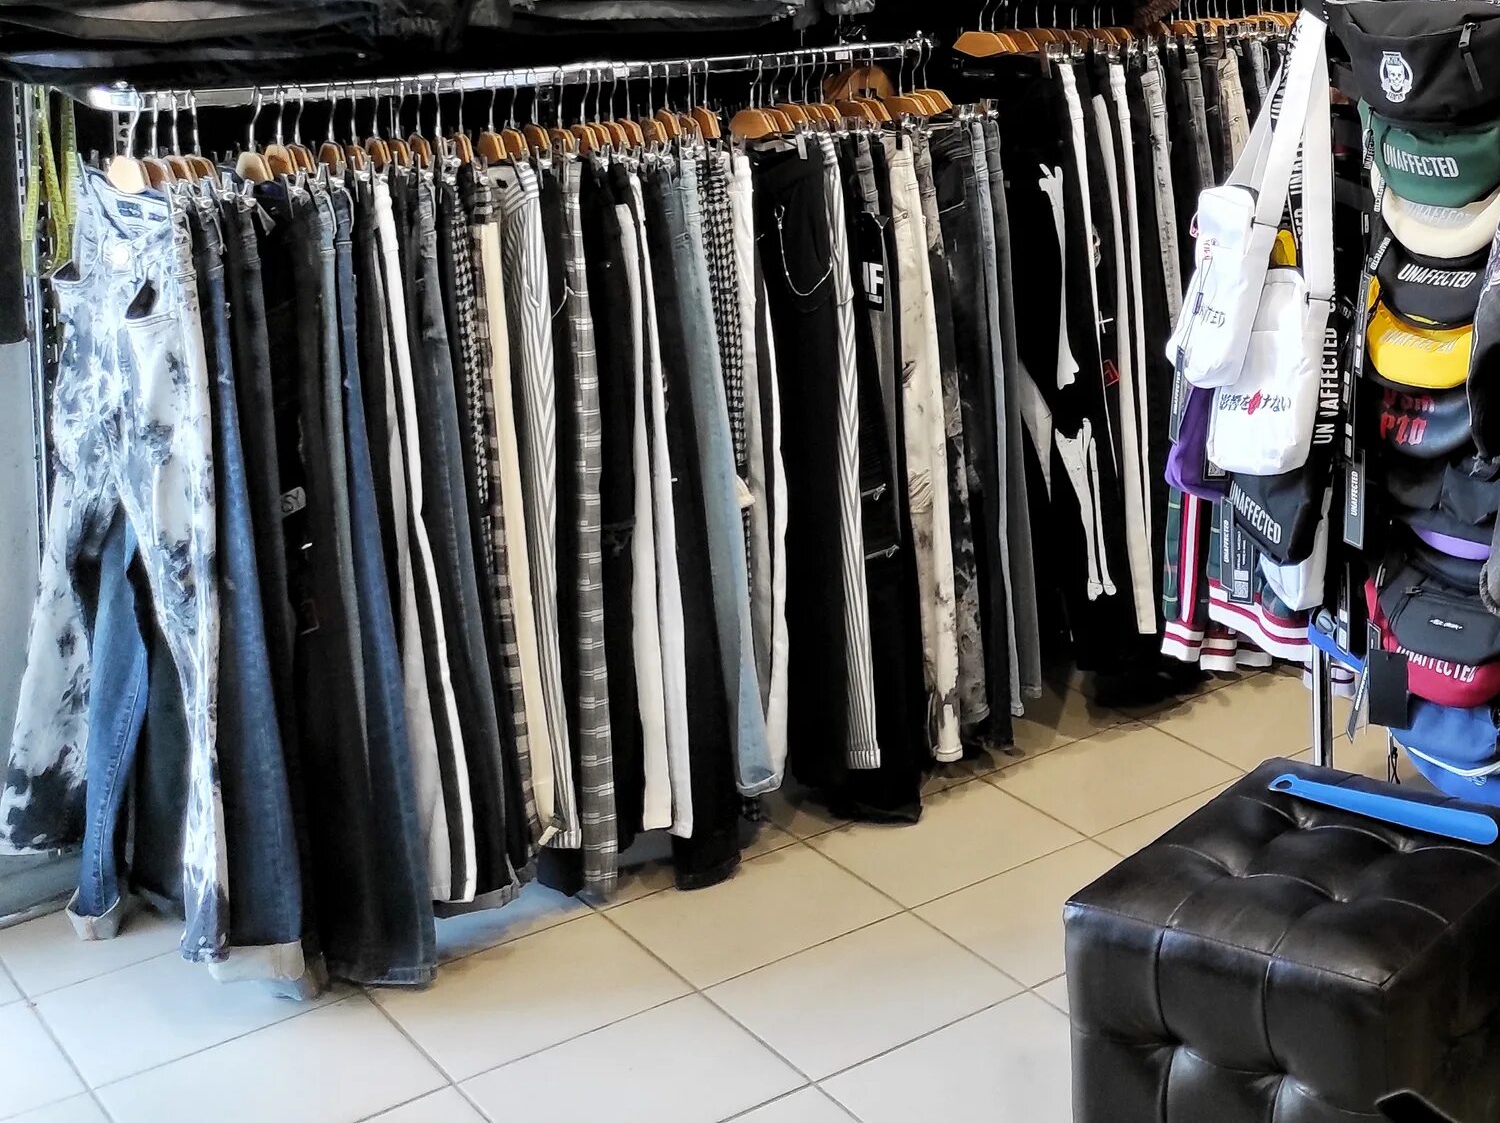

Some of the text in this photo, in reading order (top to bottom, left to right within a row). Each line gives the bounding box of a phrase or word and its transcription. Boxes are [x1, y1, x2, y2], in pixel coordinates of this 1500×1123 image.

[1383, 142, 1460, 178] UNAFFECTED
[1397, 263, 1477, 289] UNAFFECTED
[1229, 480, 1282, 545] UNAFFECTED
[1350, 471, 1359, 517] UNAFFECTED
